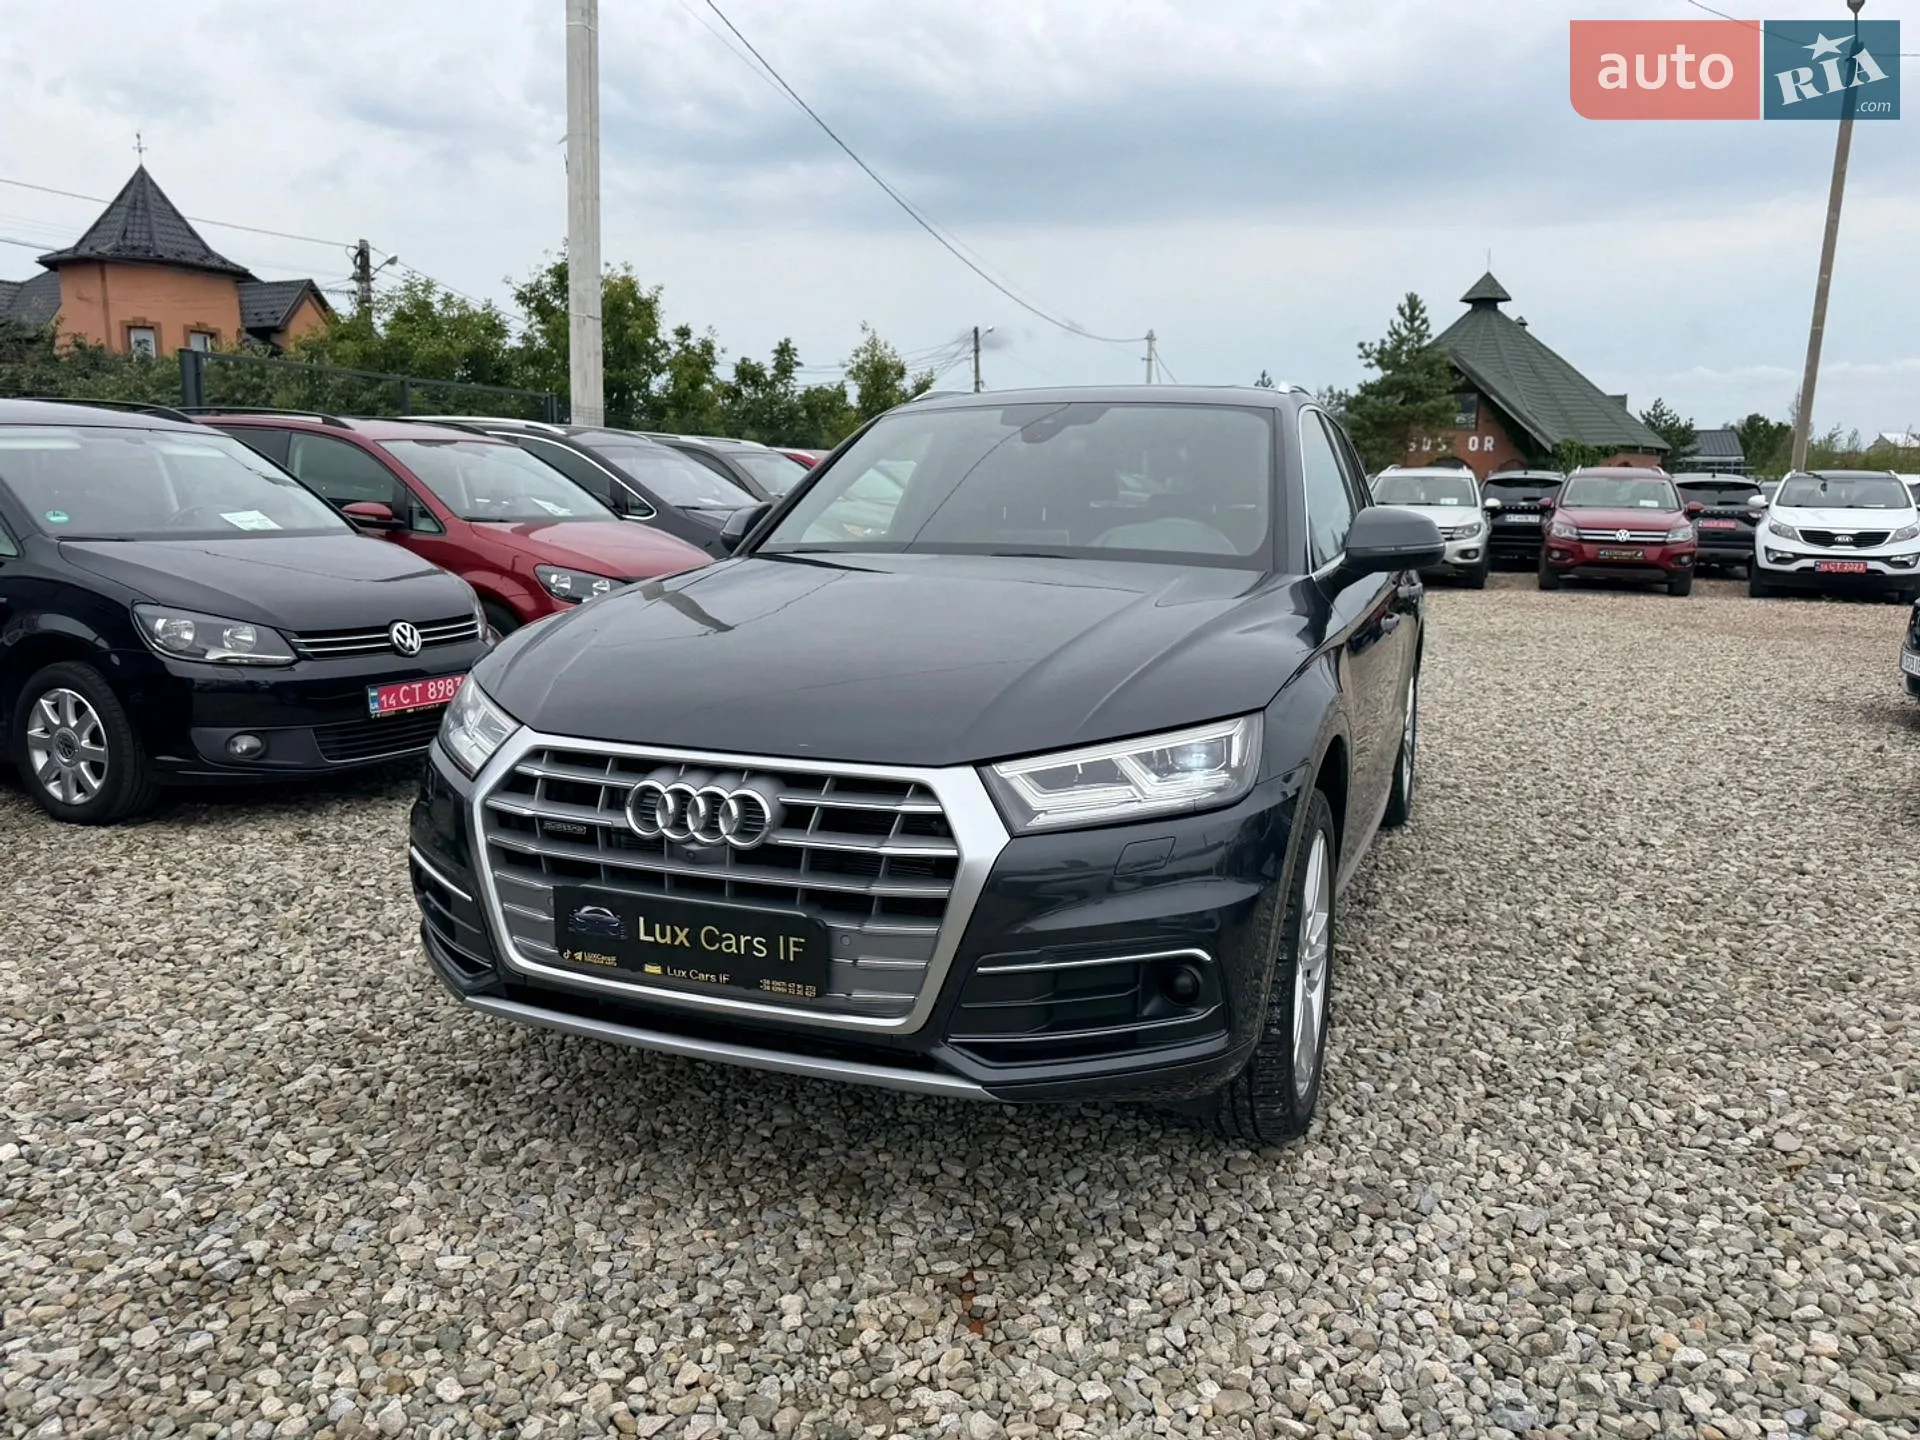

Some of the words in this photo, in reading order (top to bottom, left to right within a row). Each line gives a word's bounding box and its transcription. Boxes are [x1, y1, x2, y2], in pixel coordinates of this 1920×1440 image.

[381, 693, 397, 708] 14
[400, 684, 422, 704] CT
[638, 916, 691, 948] Lux
[700, 925, 767, 958] Cars
[779, 935, 806, 962] IF
[667, 965, 687, 978] Lux
[689, 969, 717, 983] Cars
[719, 973, 731, 984] IF
